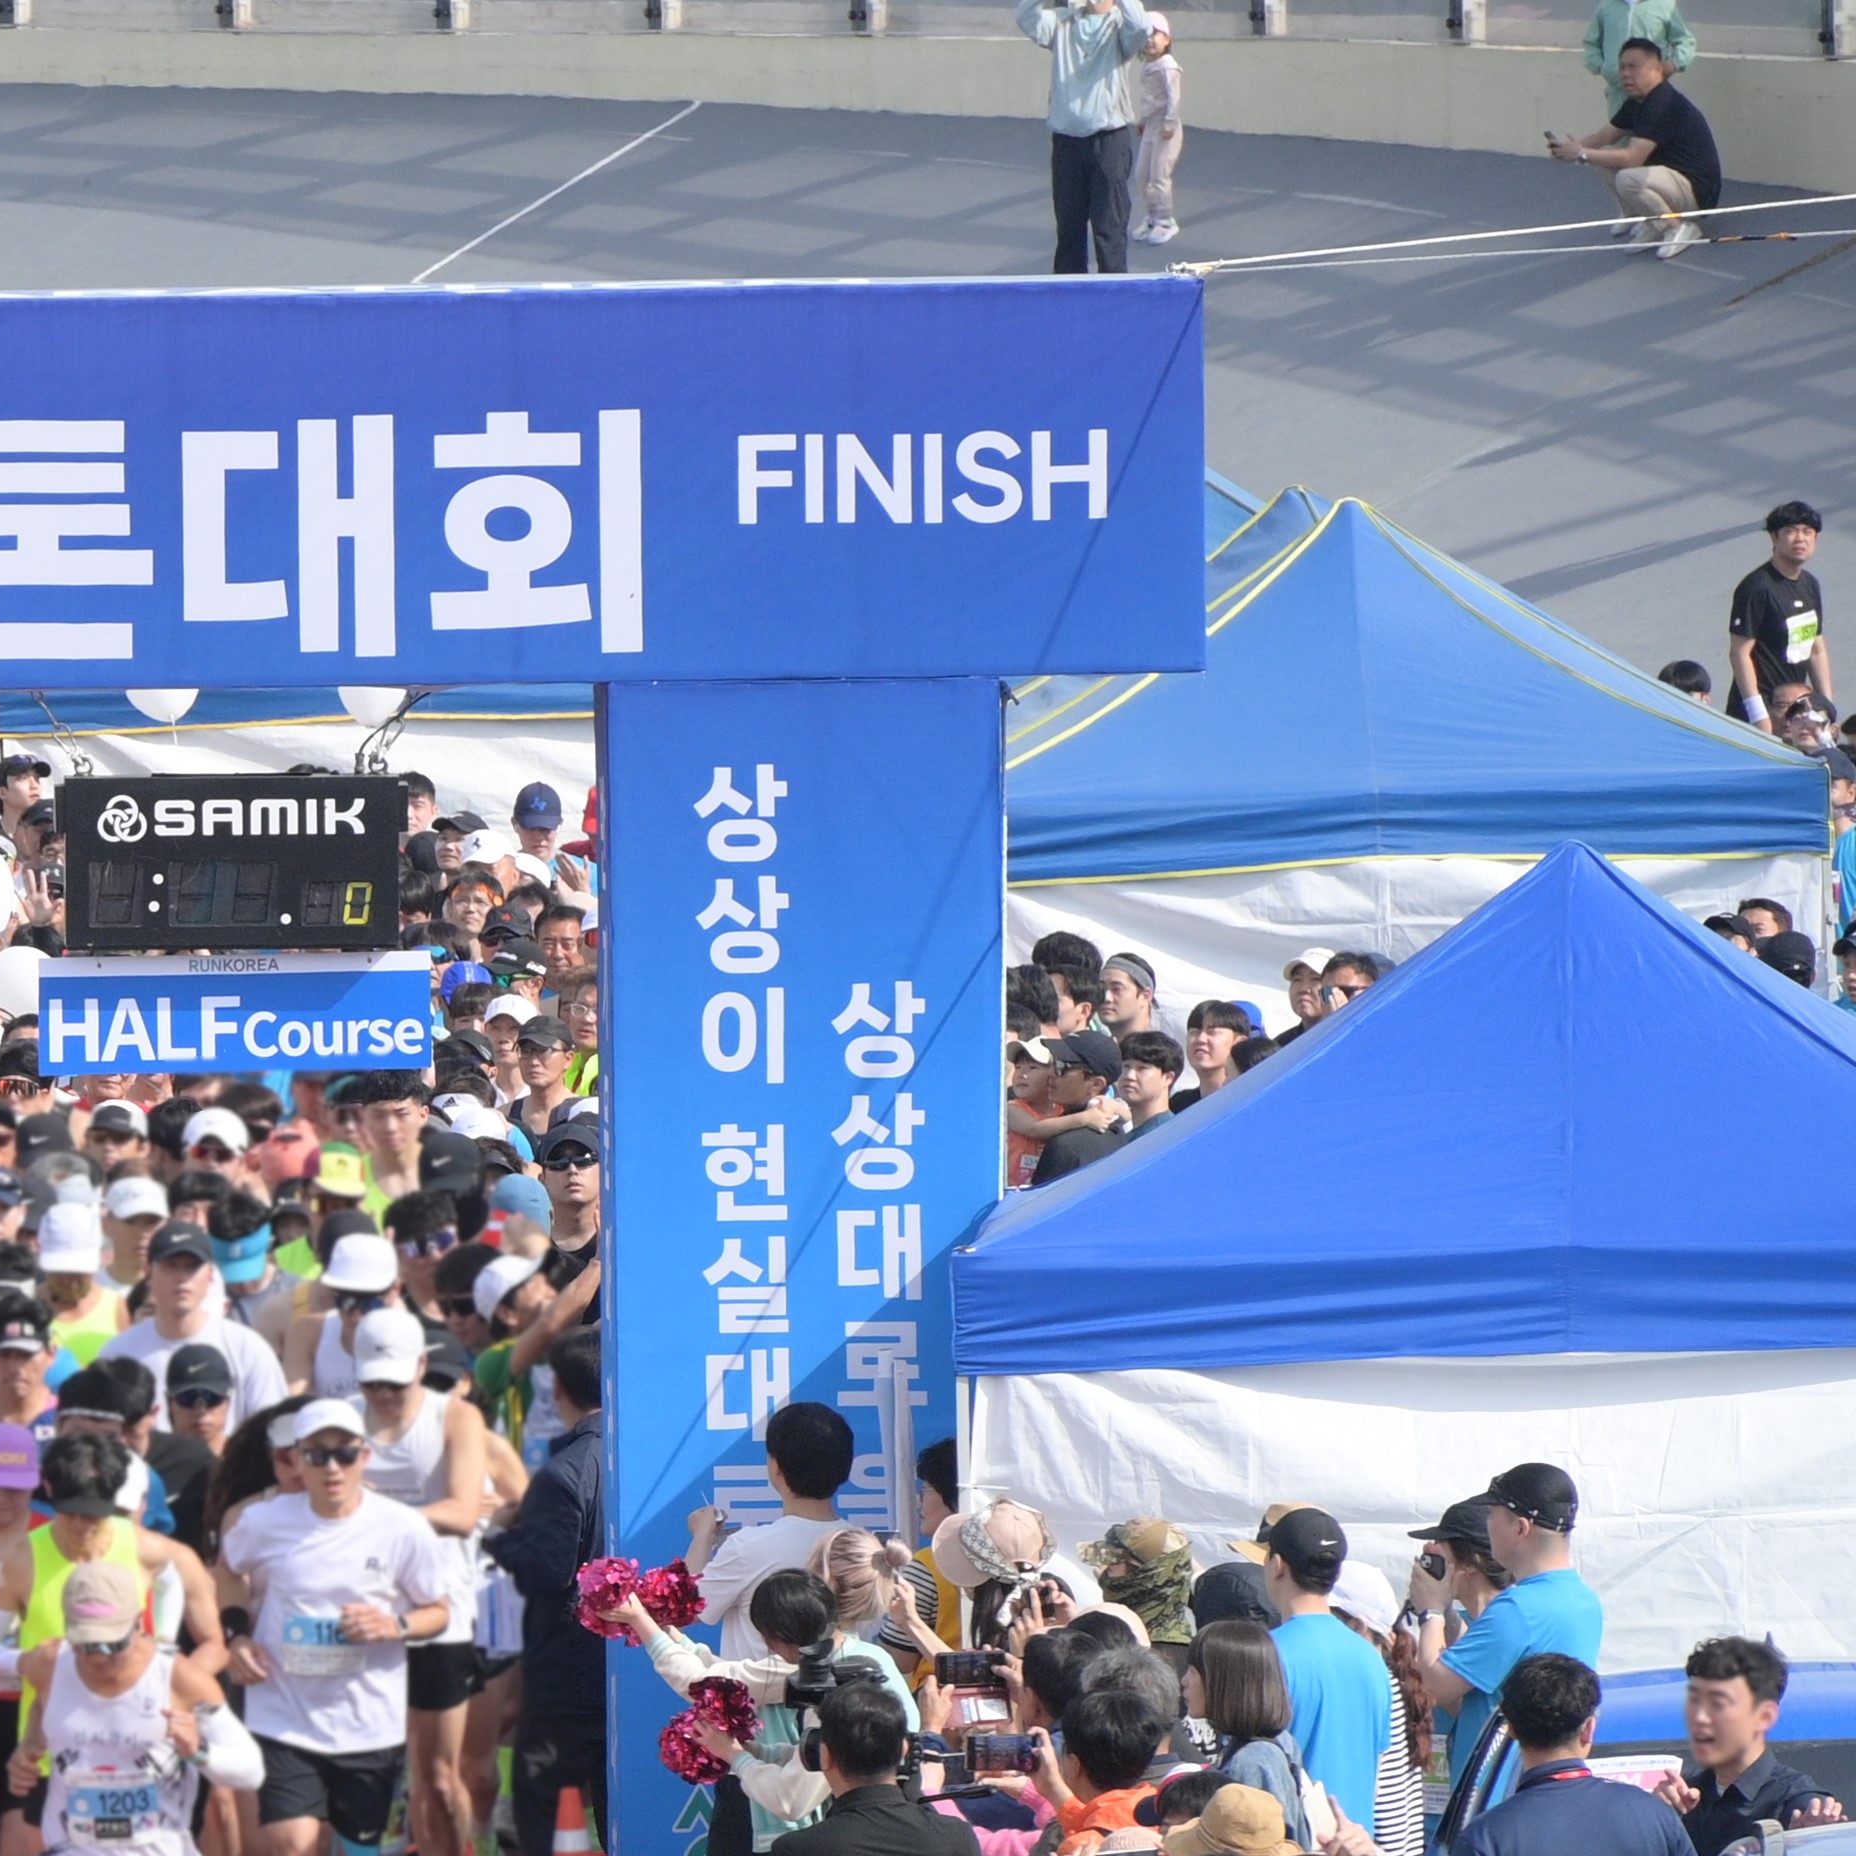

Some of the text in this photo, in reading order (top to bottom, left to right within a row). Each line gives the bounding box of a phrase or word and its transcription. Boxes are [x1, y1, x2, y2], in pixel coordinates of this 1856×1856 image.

[736, 427, 1109, 526] FINISH
[153, 797, 367, 837] SAMIK
[692, 762, 790, 1085] 상상이
[187, 957, 281, 974] RUNKOREA
[46, 994, 426, 1064] HALF Course
[97, 1788, 152, 1815] 1203
